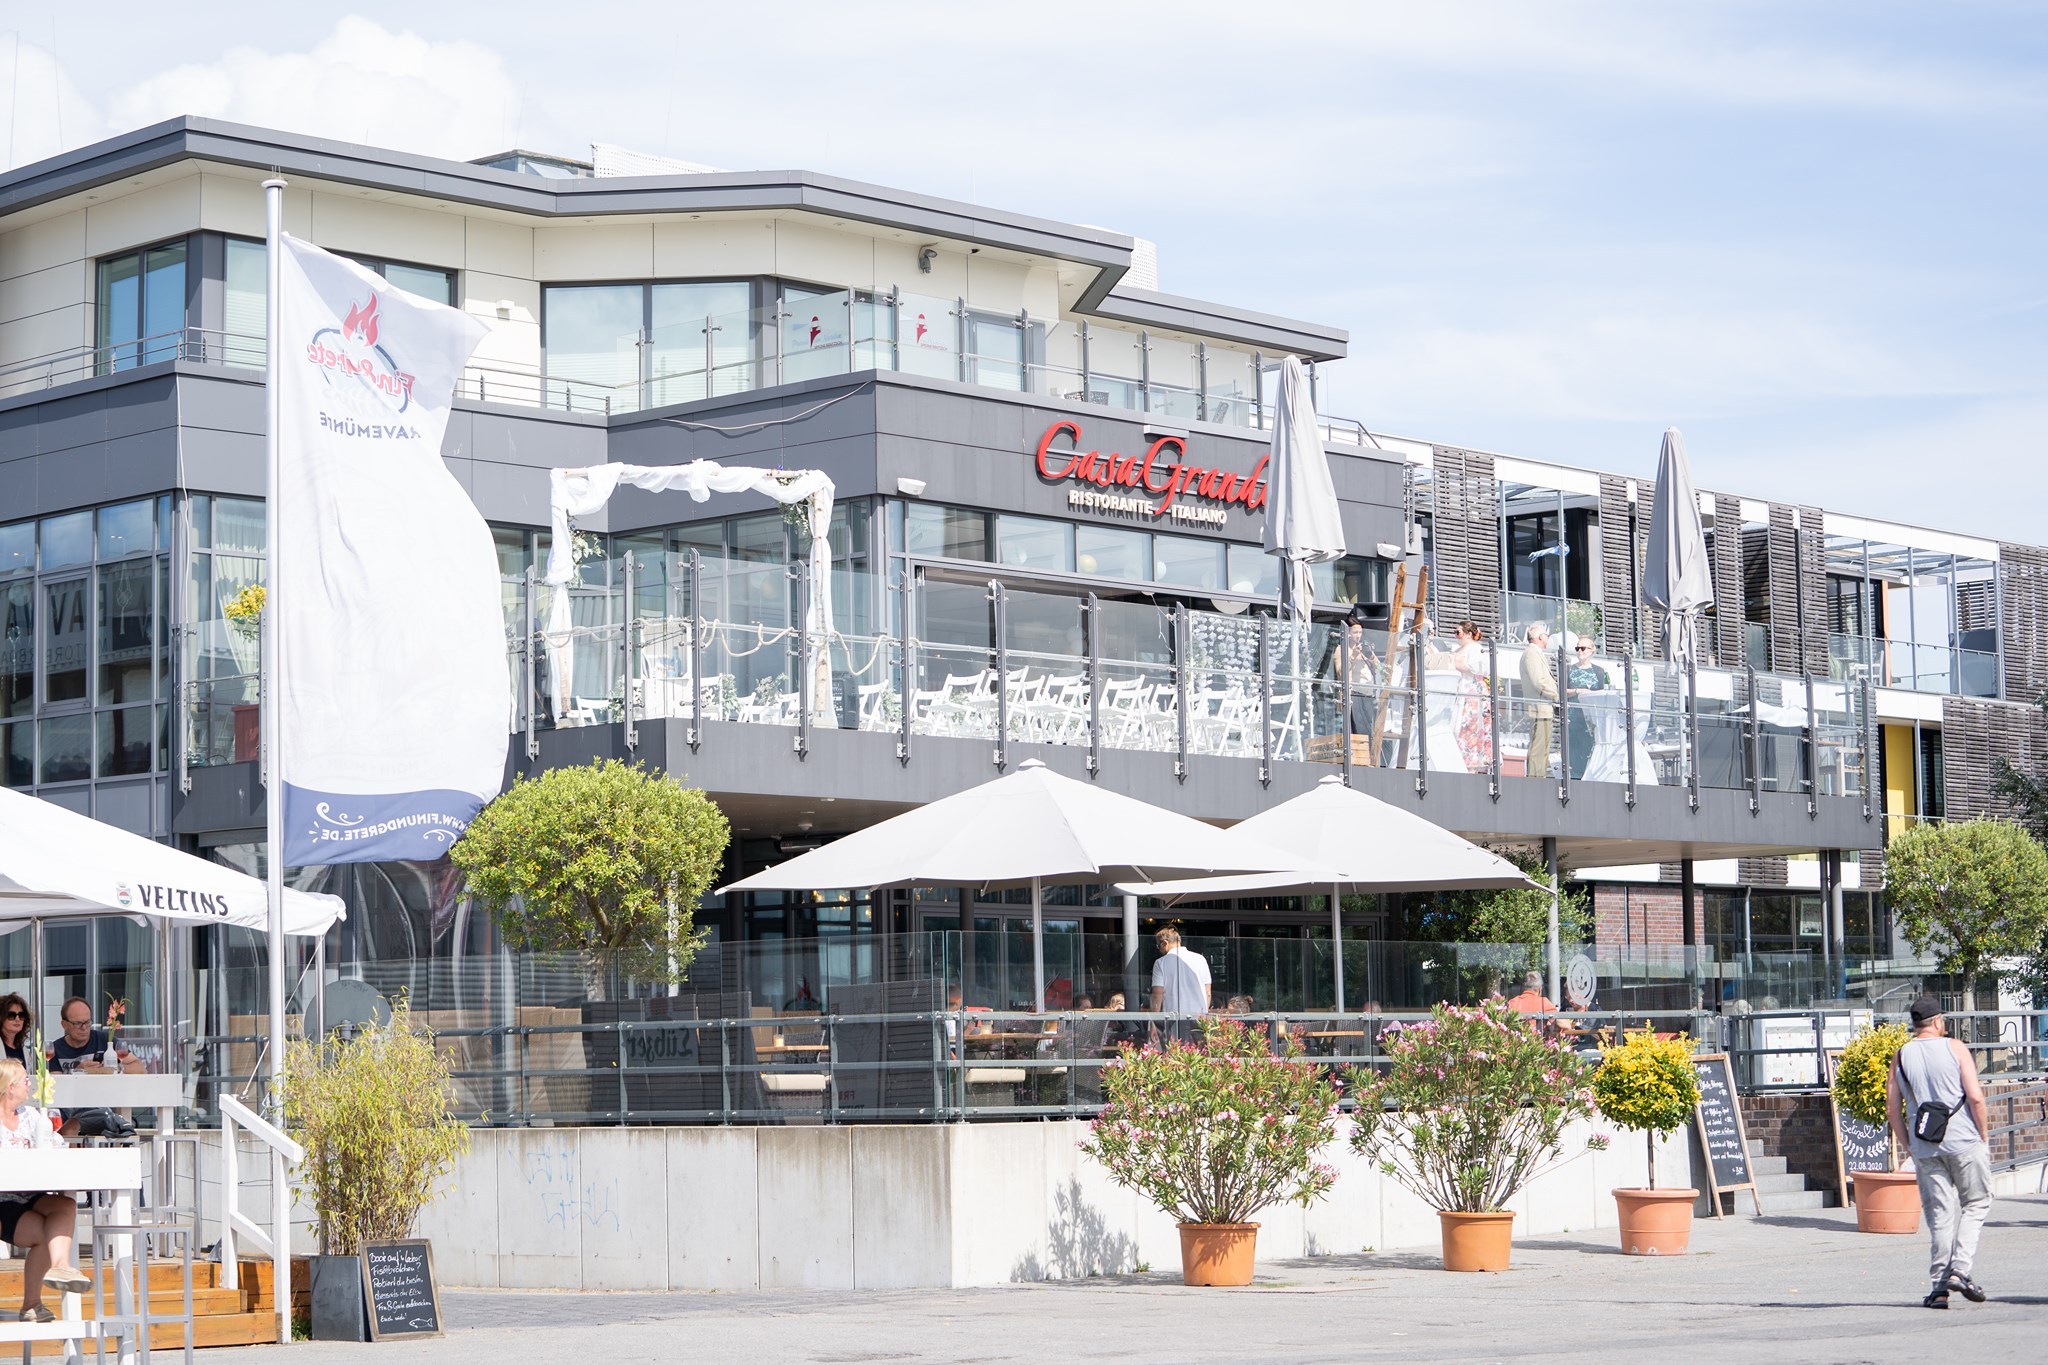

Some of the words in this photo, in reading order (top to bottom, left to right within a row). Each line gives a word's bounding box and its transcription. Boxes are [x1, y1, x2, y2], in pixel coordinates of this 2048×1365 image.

[1037, 421, 1270, 515] CasaGrand
[1069, 489, 1153, 515] RISTORANTE
[1171, 504, 1227, 524] ITALIANO
[137, 884, 228, 916] VELTINS
[1848, 1161, 1883, 1171] 22.08.2020
